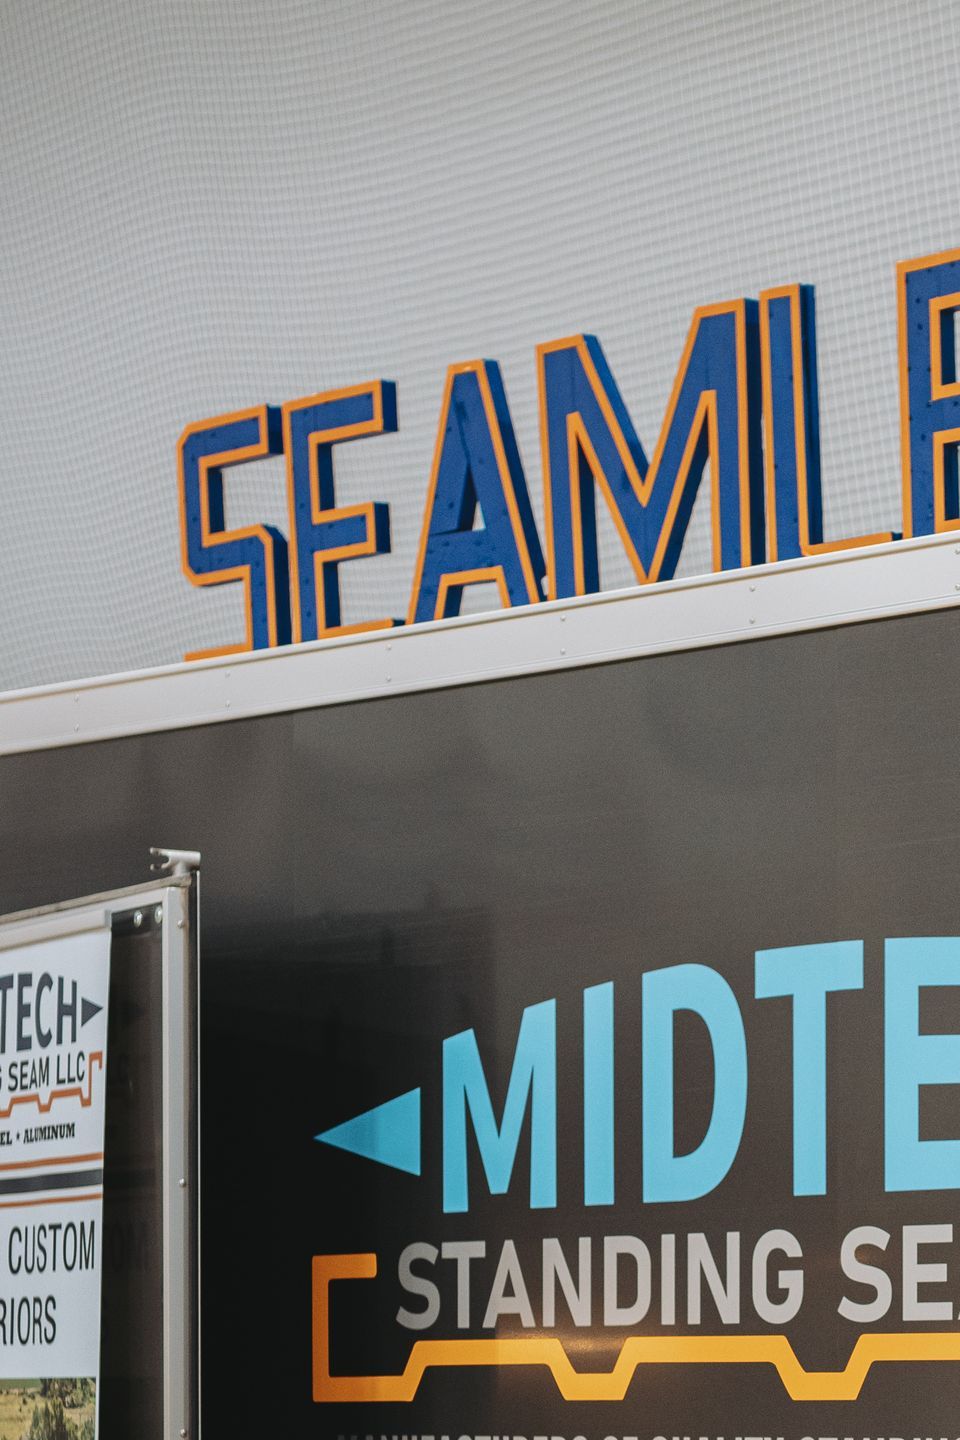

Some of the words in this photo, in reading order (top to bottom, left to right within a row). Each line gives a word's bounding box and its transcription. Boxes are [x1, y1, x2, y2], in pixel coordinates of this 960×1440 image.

[8, 1057, 49, 1092] SEAM
[56, 1051, 85, 1085] LLC
[23, 1123, 75, 1144] ALUMINUM
[8, 1220, 95, 1275] CUSTOM
[395, 1229, 804, 1330] STANDING
